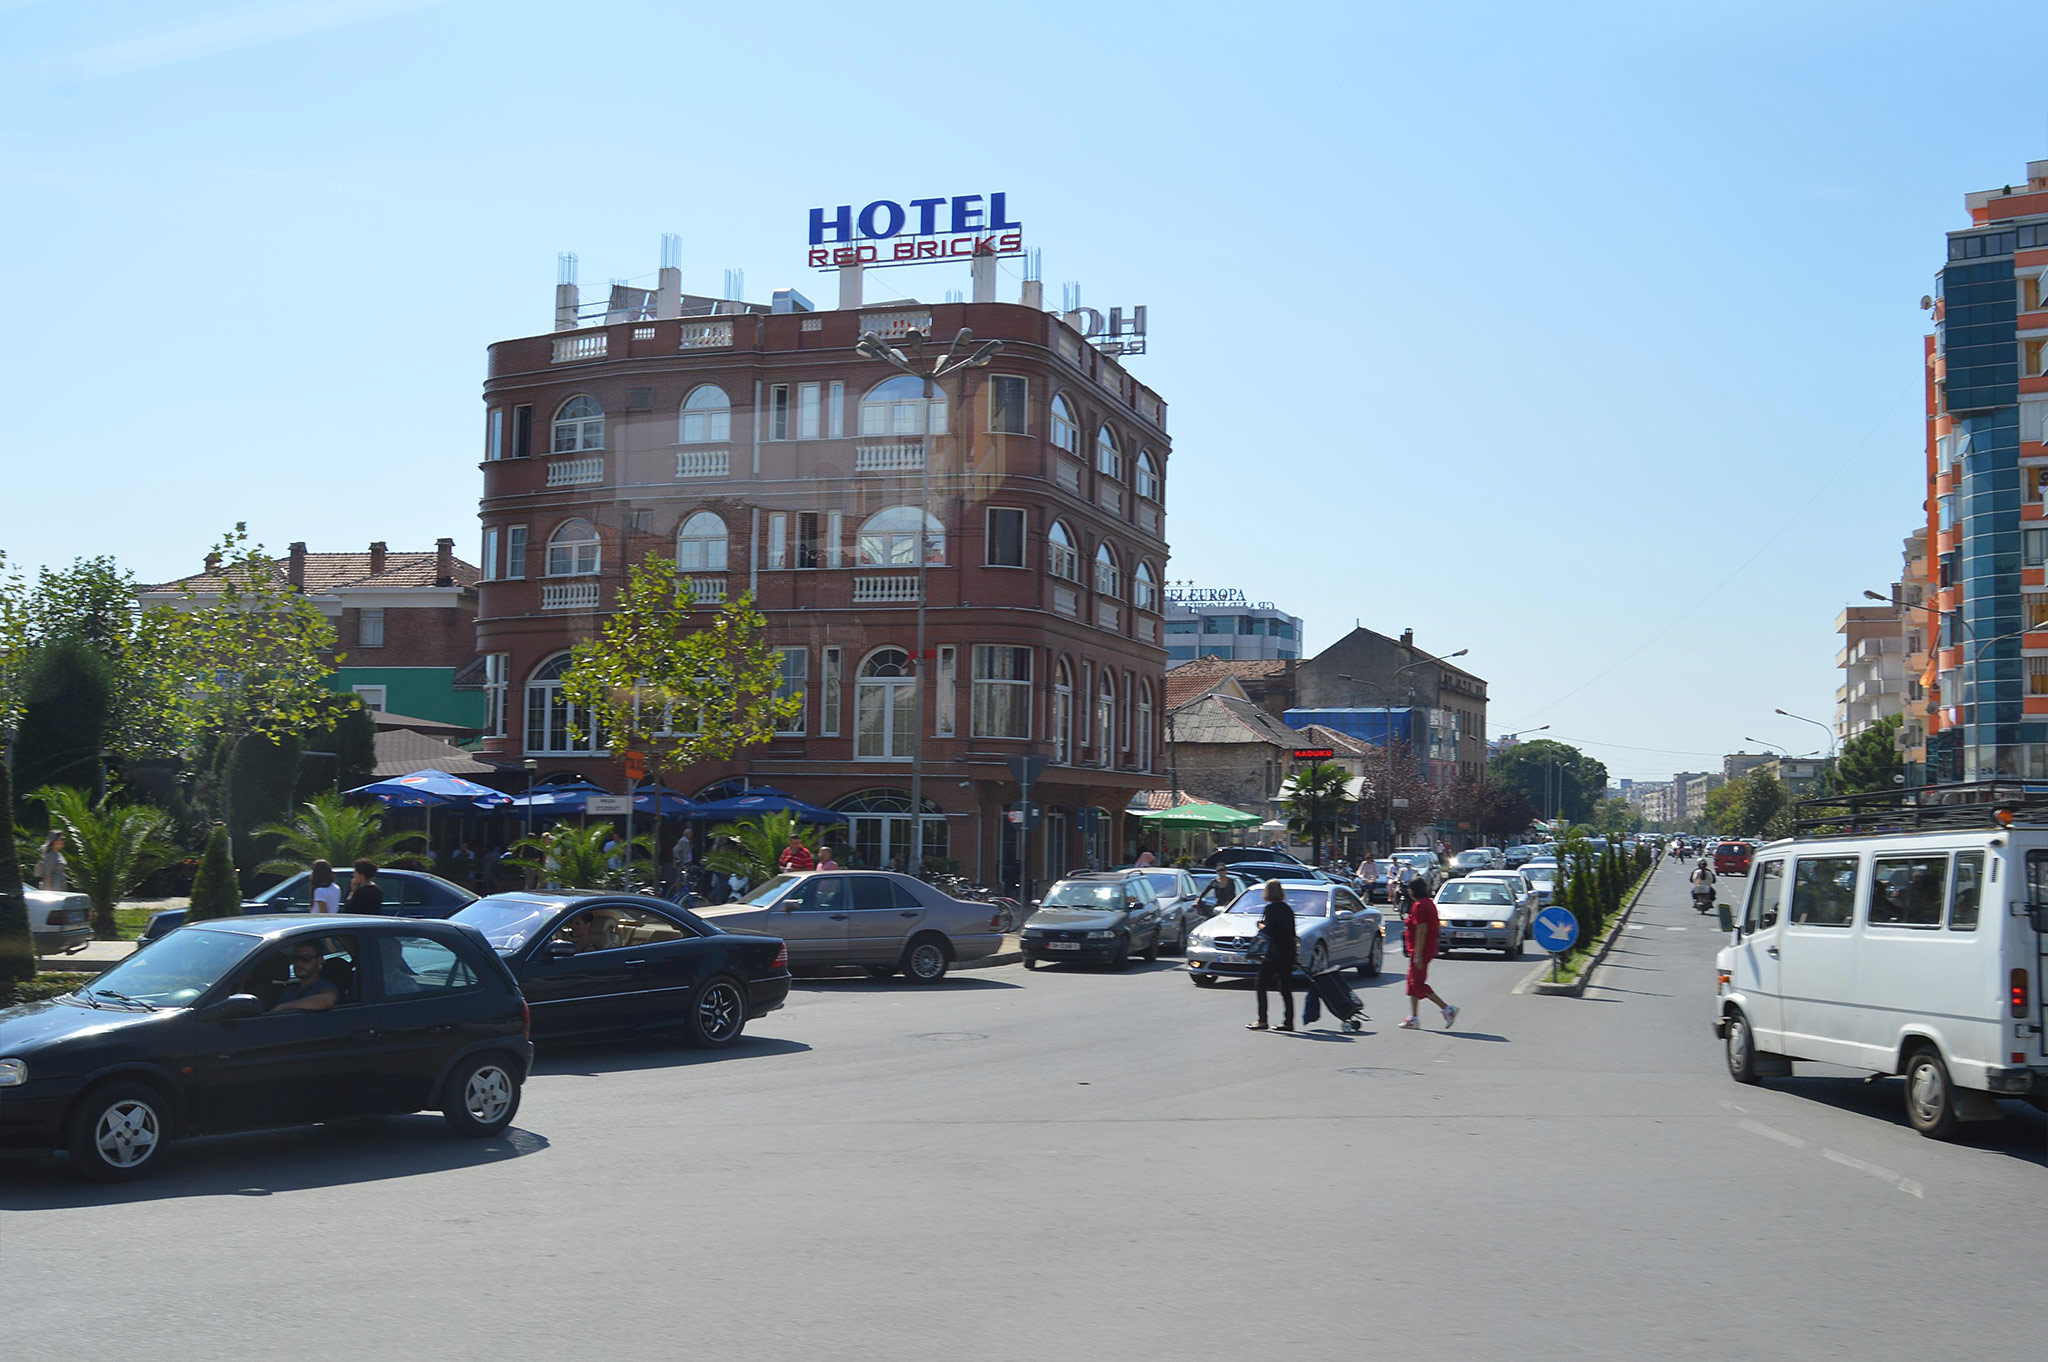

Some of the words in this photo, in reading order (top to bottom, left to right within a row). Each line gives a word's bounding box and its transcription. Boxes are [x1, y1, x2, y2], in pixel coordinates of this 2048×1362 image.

[808, 192, 1022, 246] HOTEL
[808, 246, 877, 268] RED
[893, 233, 1022, 262] BRICKS
[1190, 588, 1246, 601] EUROPA
